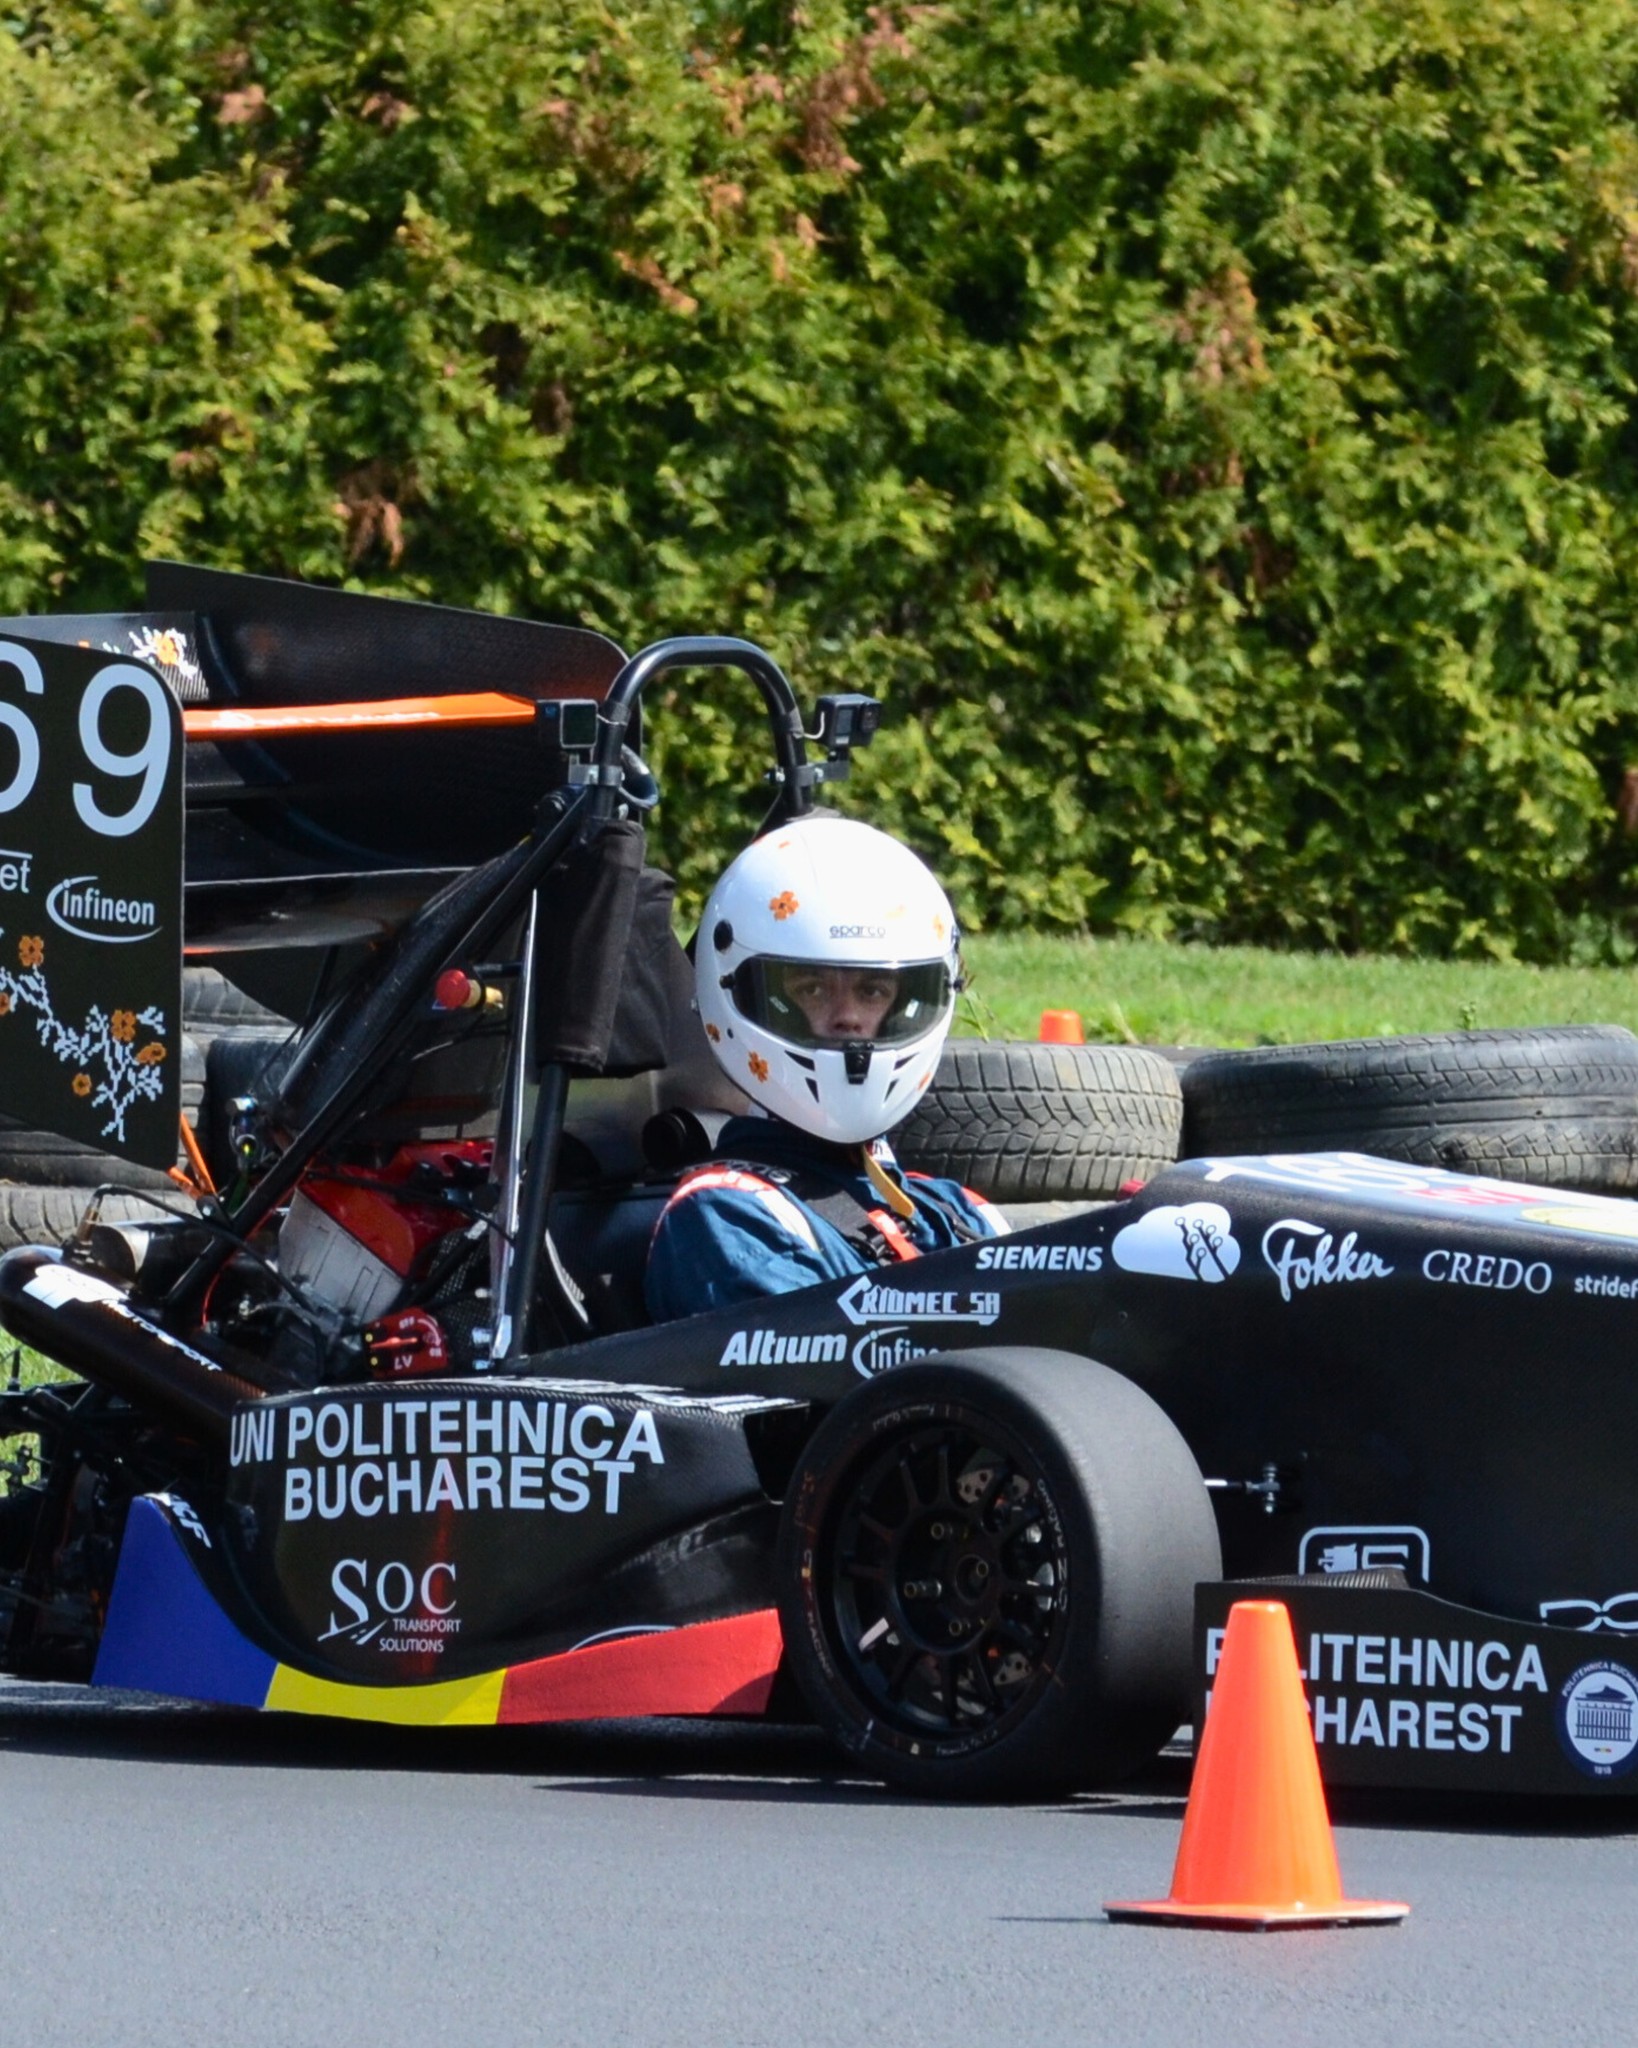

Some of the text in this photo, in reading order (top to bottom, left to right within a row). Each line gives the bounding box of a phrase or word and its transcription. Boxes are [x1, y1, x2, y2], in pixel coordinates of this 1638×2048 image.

[976, 1246, 1103, 1271] SIEMENS
[1261, 1219, 1394, 1302] Fokker
[1422, 1250, 1552, 1295] CREDO
[969, 1292, 1000, 1314] SA
[394, 1354, 413, 1370] LV
[719, 1329, 848, 1367] Altium
[230, 1400, 665, 1467] UNI POLITEHNICA
[285, 1456, 636, 1521] BUCHAREST
[317, 1558, 457, 1641] SOC
[379, 1638, 445, 1653] SOLUTIONS
[393, 1618, 461, 1633] TRANSPORT
[1206, 1628, 1548, 1692] PITEHNICA
[1206, 1690, 1523, 1753] HAREST
